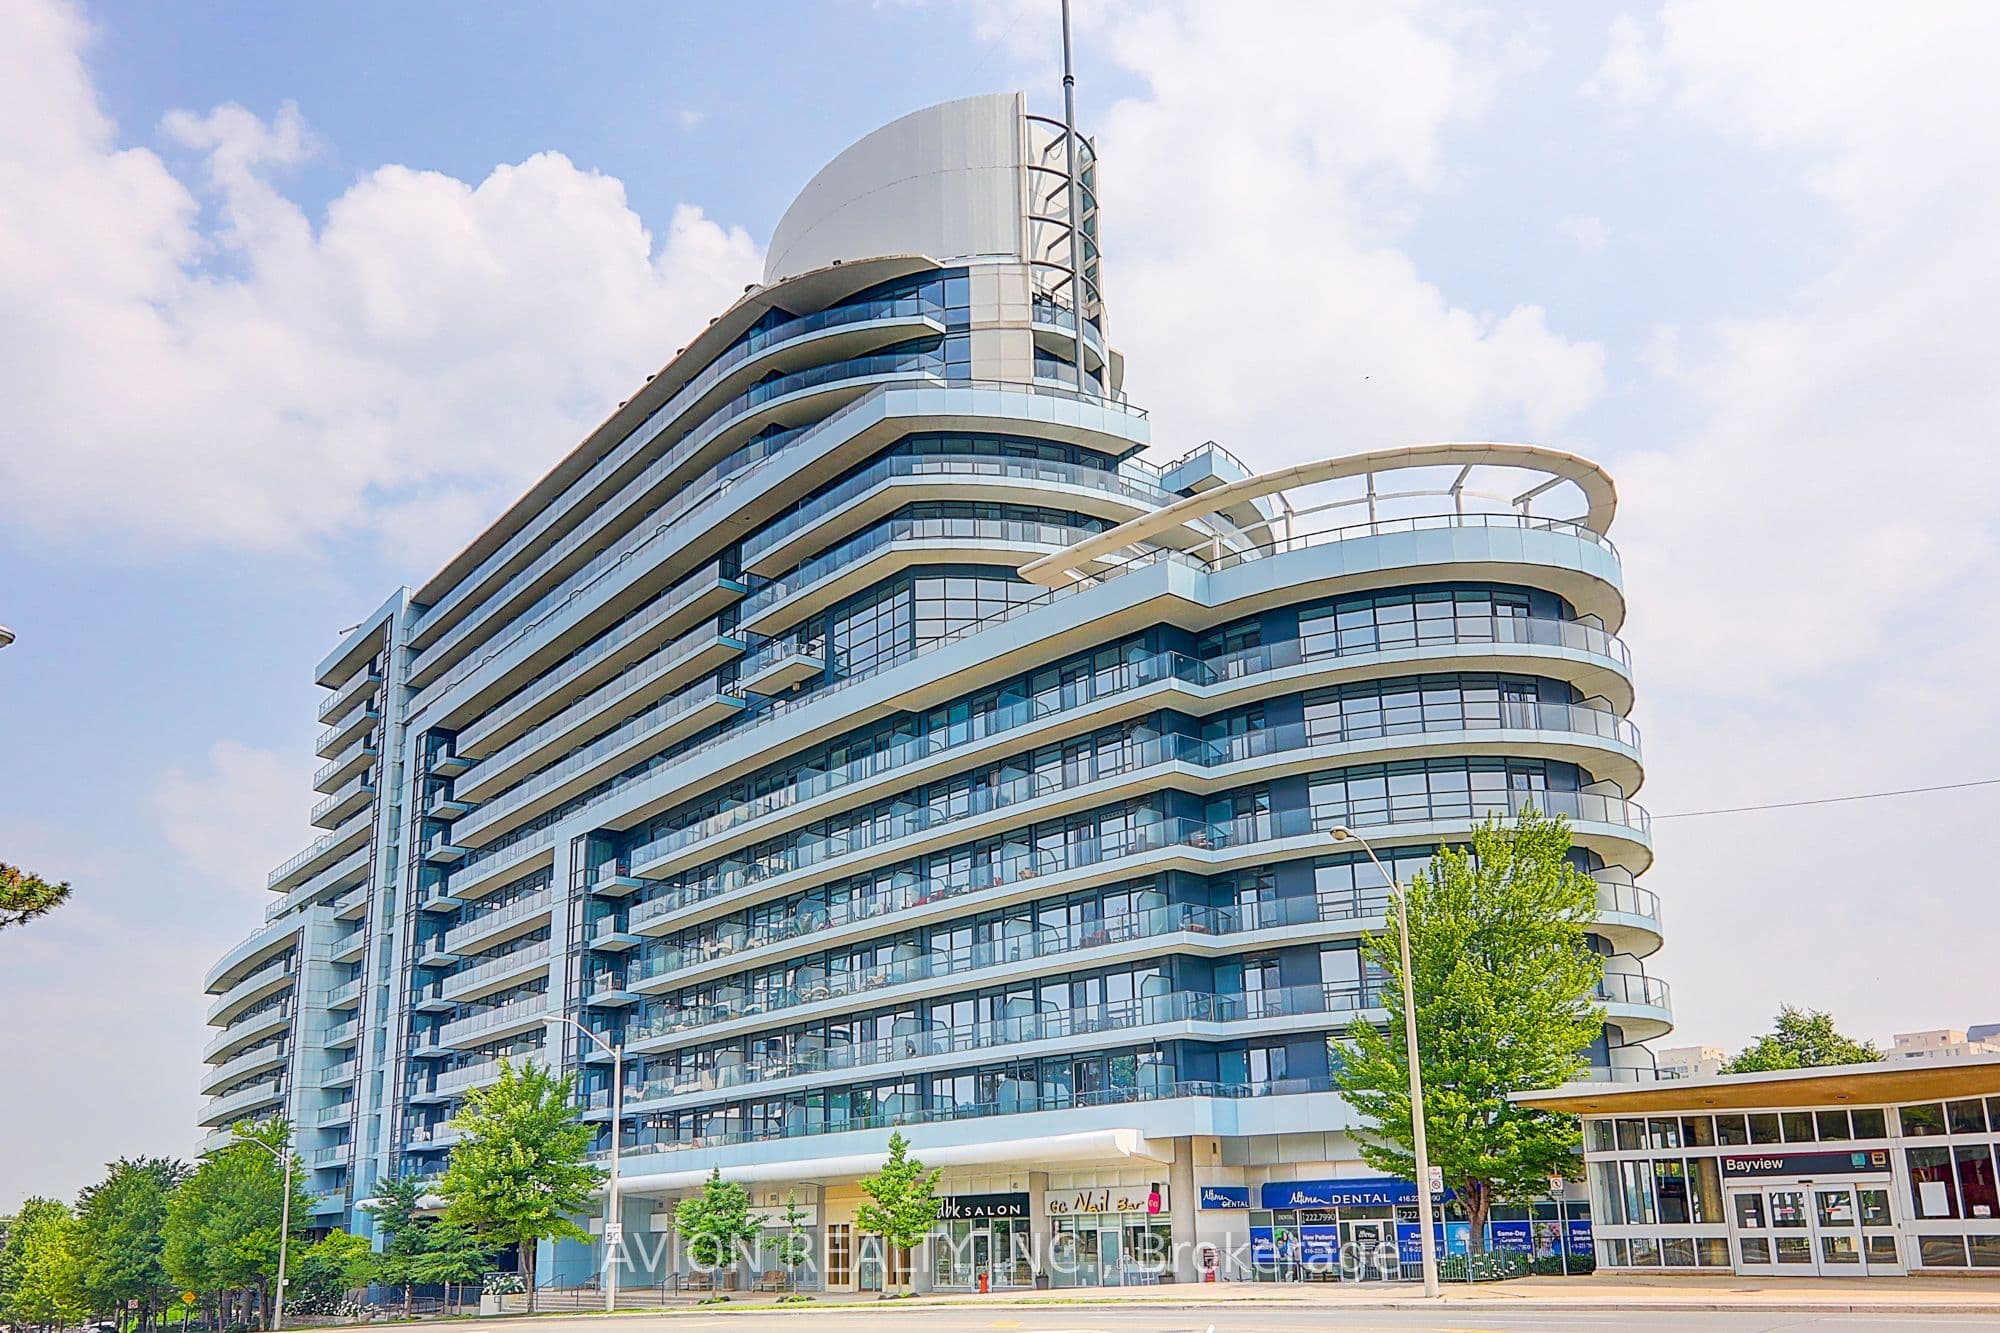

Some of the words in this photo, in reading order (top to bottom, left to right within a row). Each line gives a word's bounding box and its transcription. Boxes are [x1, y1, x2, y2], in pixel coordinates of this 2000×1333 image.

[1726, 1157, 1783, 1173] Bayview
[1074, 1189, 1110, 1213] Nail
[1116, 1196, 1144, 1212] Bar
[1222, 1200, 1249, 1208] DENTAL
[1331, 1193, 1391, 1205] DENTAL
[964, 1204, 1021, 1217] SALON
